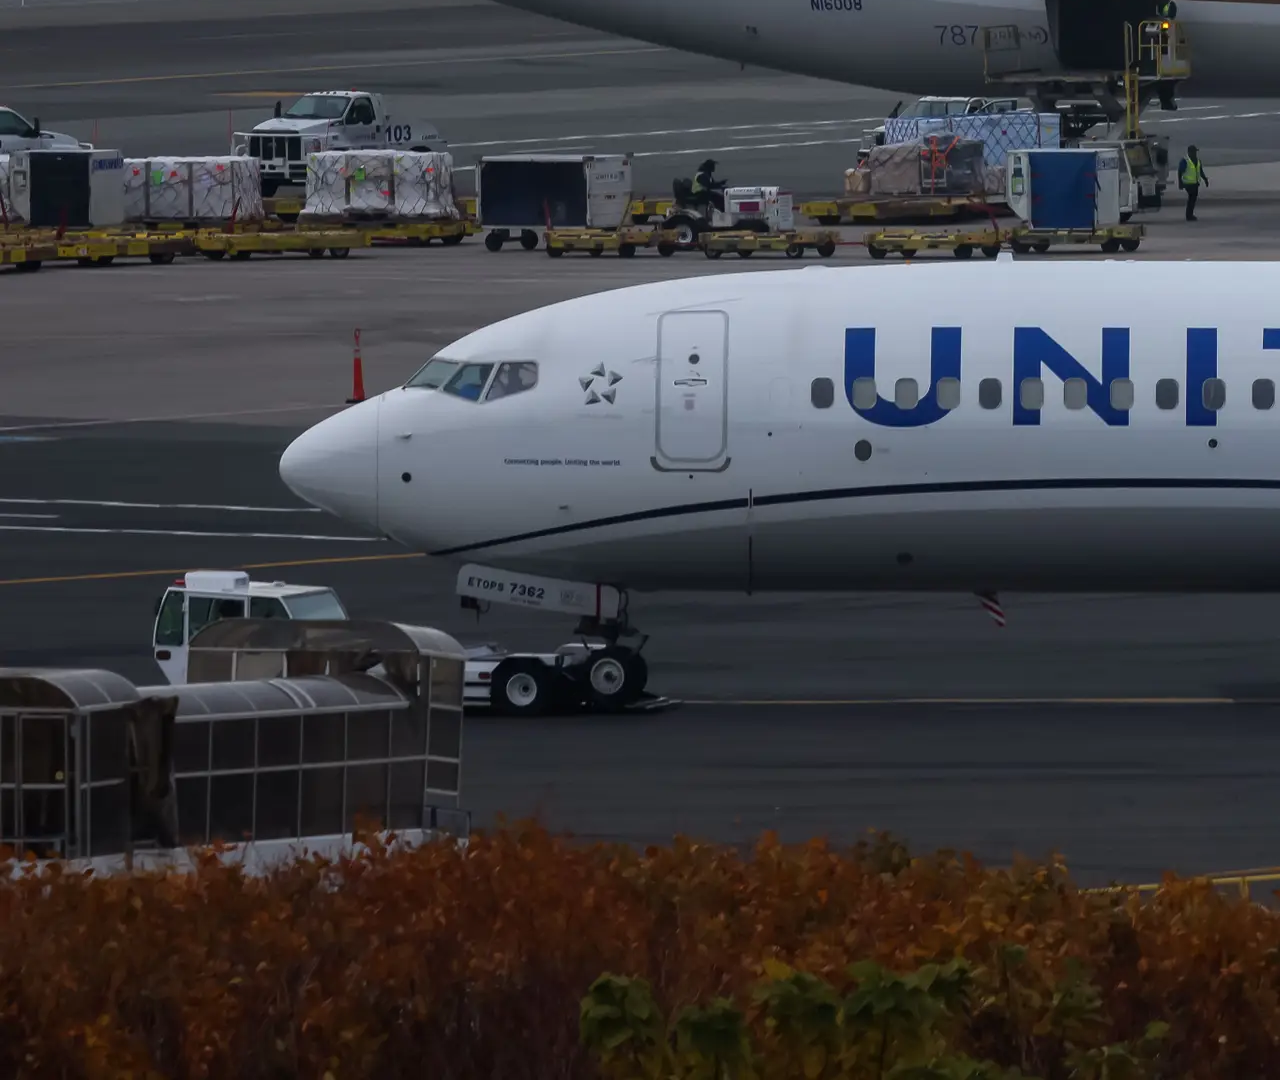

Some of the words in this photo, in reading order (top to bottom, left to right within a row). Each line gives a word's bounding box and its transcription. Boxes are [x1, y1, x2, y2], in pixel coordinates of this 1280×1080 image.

[934, 25, 979, 48] 787
[385, 124, 412, 144] 103
[467, 576, 504, 592] ETOPS
[509, 582, 545, 600] 7362
